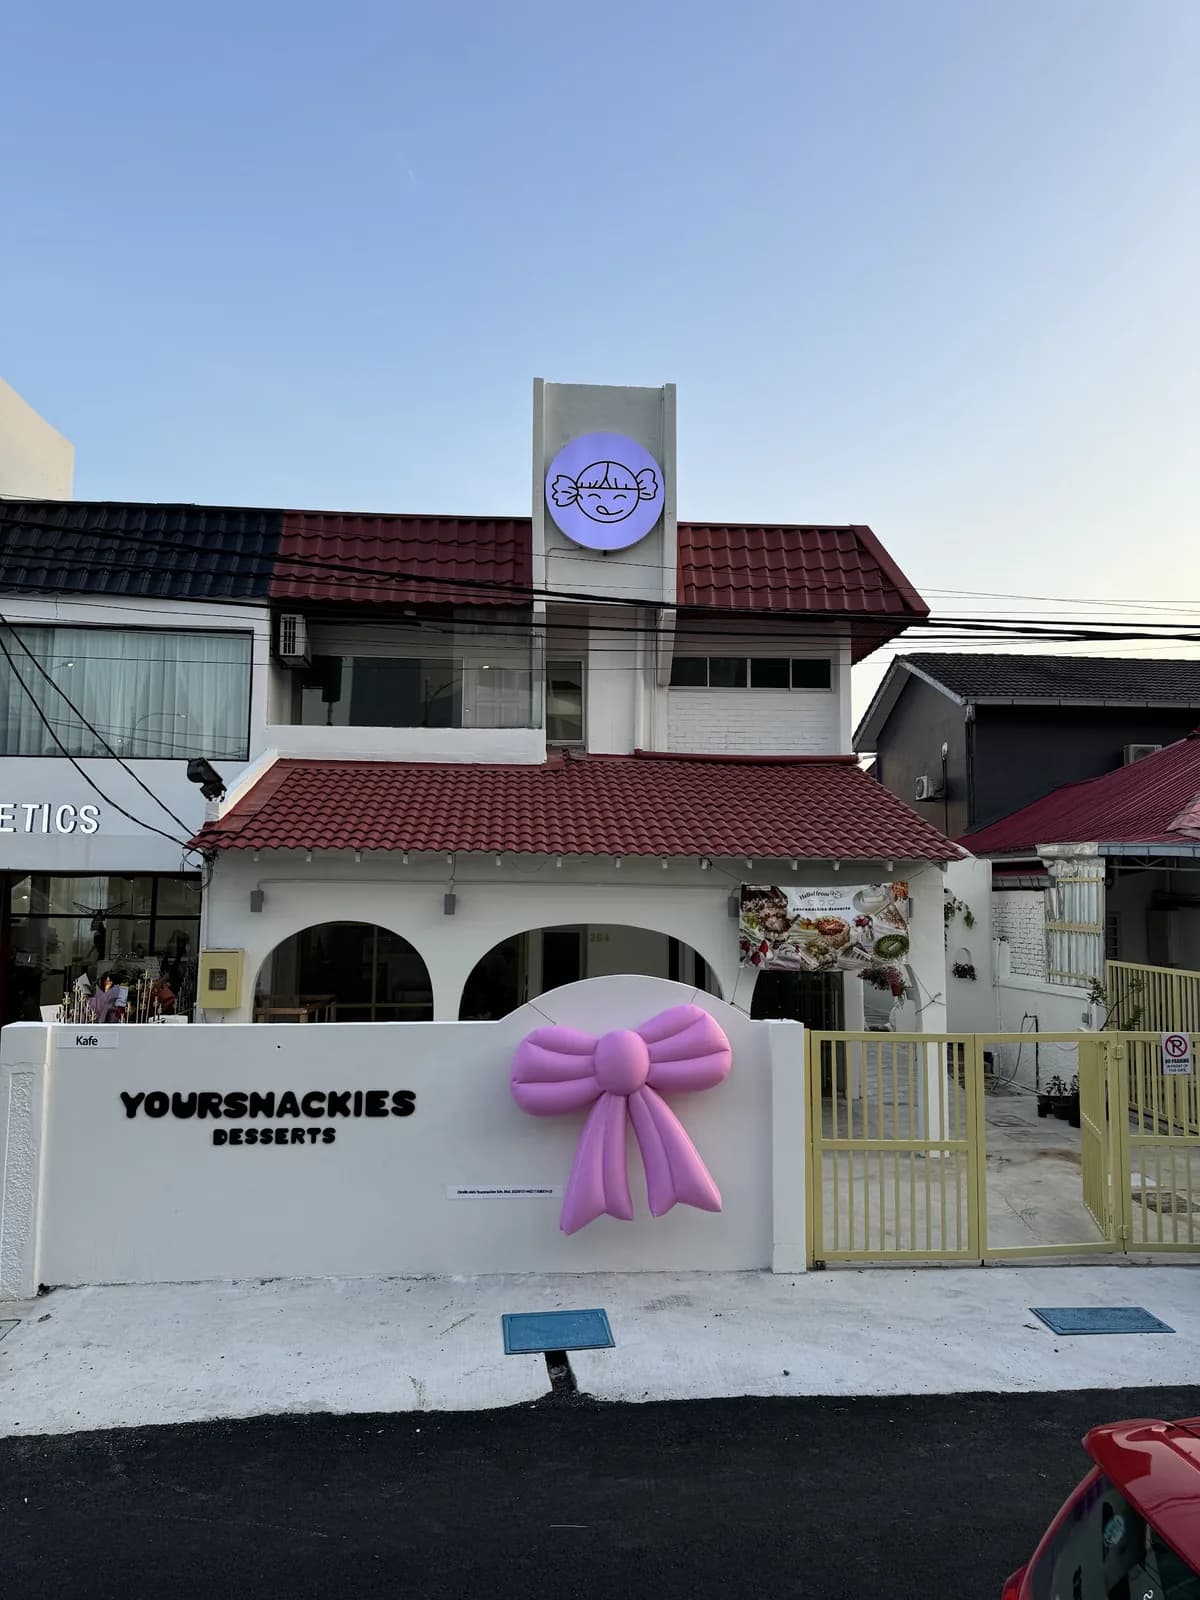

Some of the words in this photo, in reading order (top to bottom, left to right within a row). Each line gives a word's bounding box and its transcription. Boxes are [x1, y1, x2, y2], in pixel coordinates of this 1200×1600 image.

[0, 803, 101, 834] ETICS
[76, 1035, 98, 1046] Kafe
[120, 1090, 417, 1119] YOURSNACKIES
[212, 1127, 336, 1146] DESSERTS
